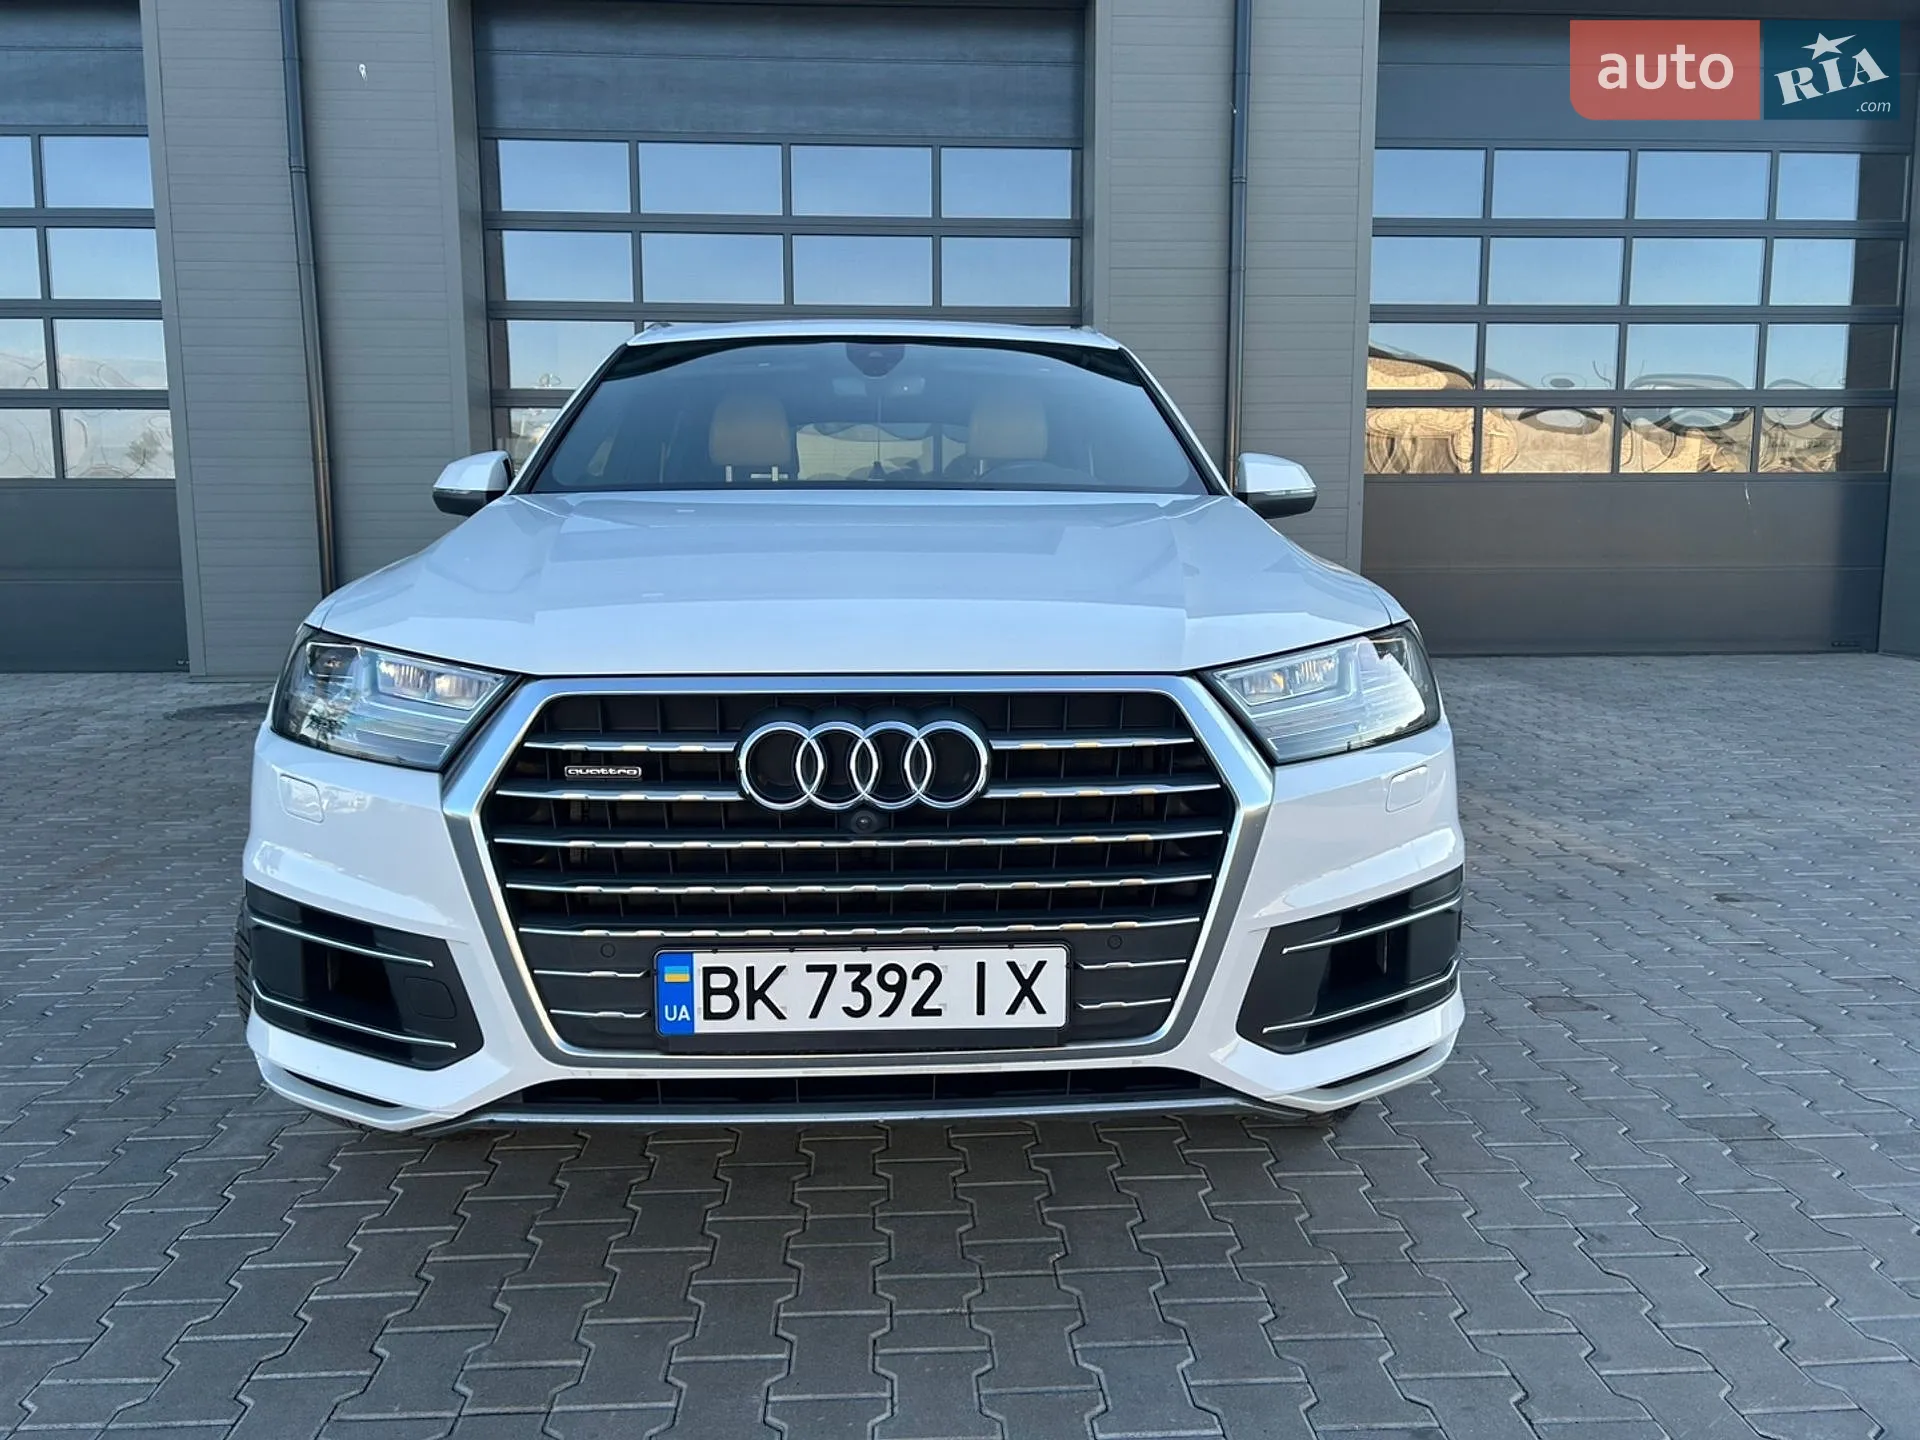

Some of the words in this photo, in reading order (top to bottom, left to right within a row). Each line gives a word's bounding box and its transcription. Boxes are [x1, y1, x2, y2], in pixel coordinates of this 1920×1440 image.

[567, 767, 638, 776] quattro
[702, 964, 787, 1020] BK
[805, 962, 943, 1018] 7392
[664, 1006, 691, 1022] UA
